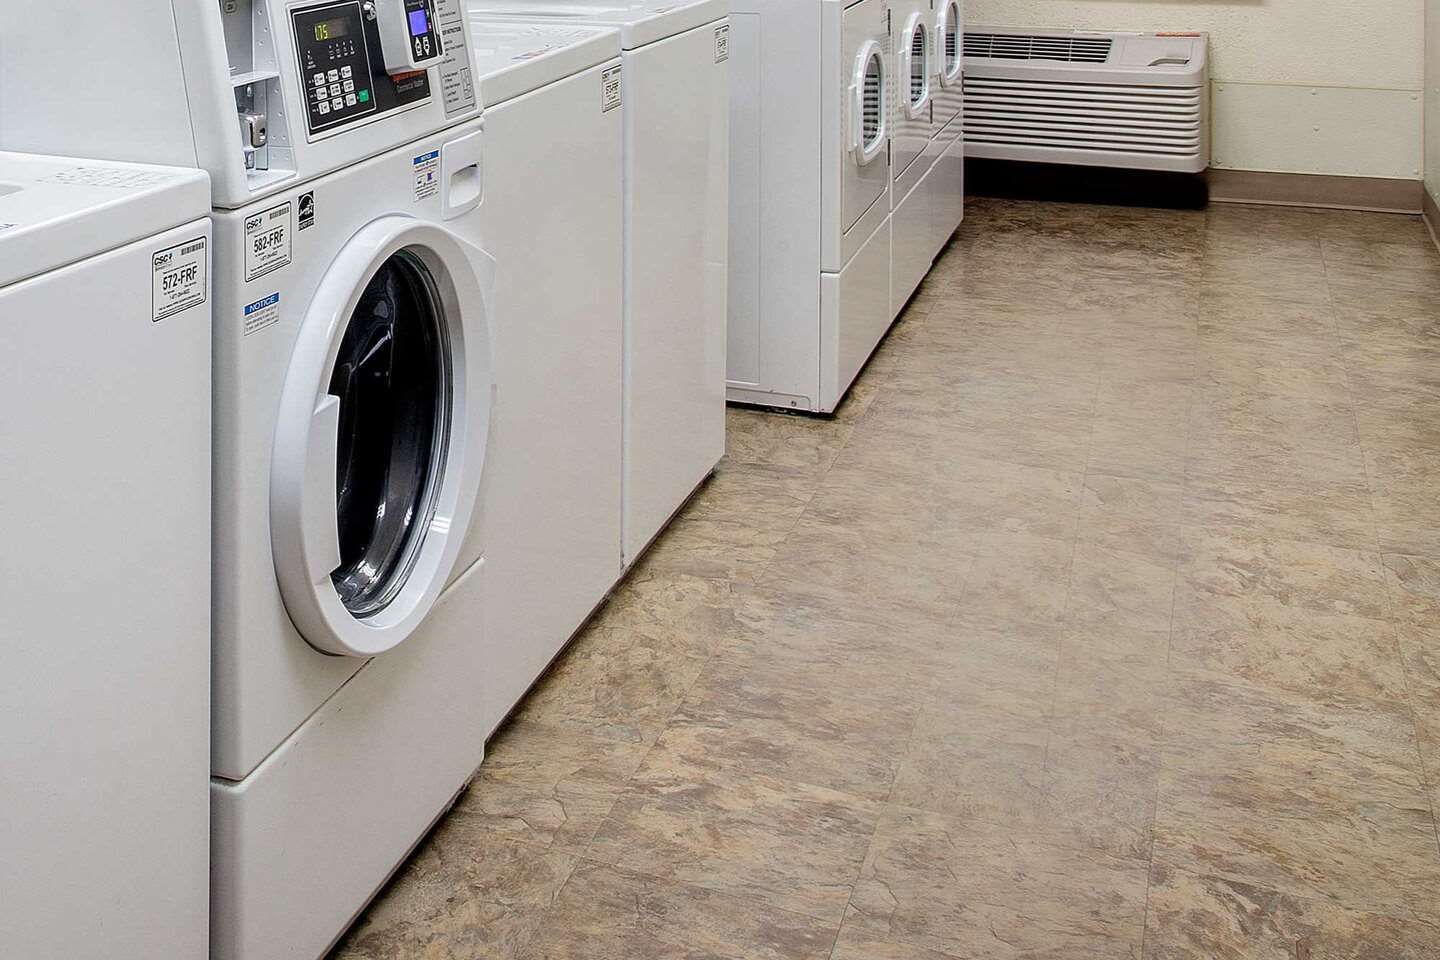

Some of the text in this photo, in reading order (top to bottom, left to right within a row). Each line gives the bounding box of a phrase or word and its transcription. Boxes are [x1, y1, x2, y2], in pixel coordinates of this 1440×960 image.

[254, 228, 284, 253] 582-FRF
[162, 265, 198, 290] 572-FRF
[250, 296, 276, 312] NOTICE
